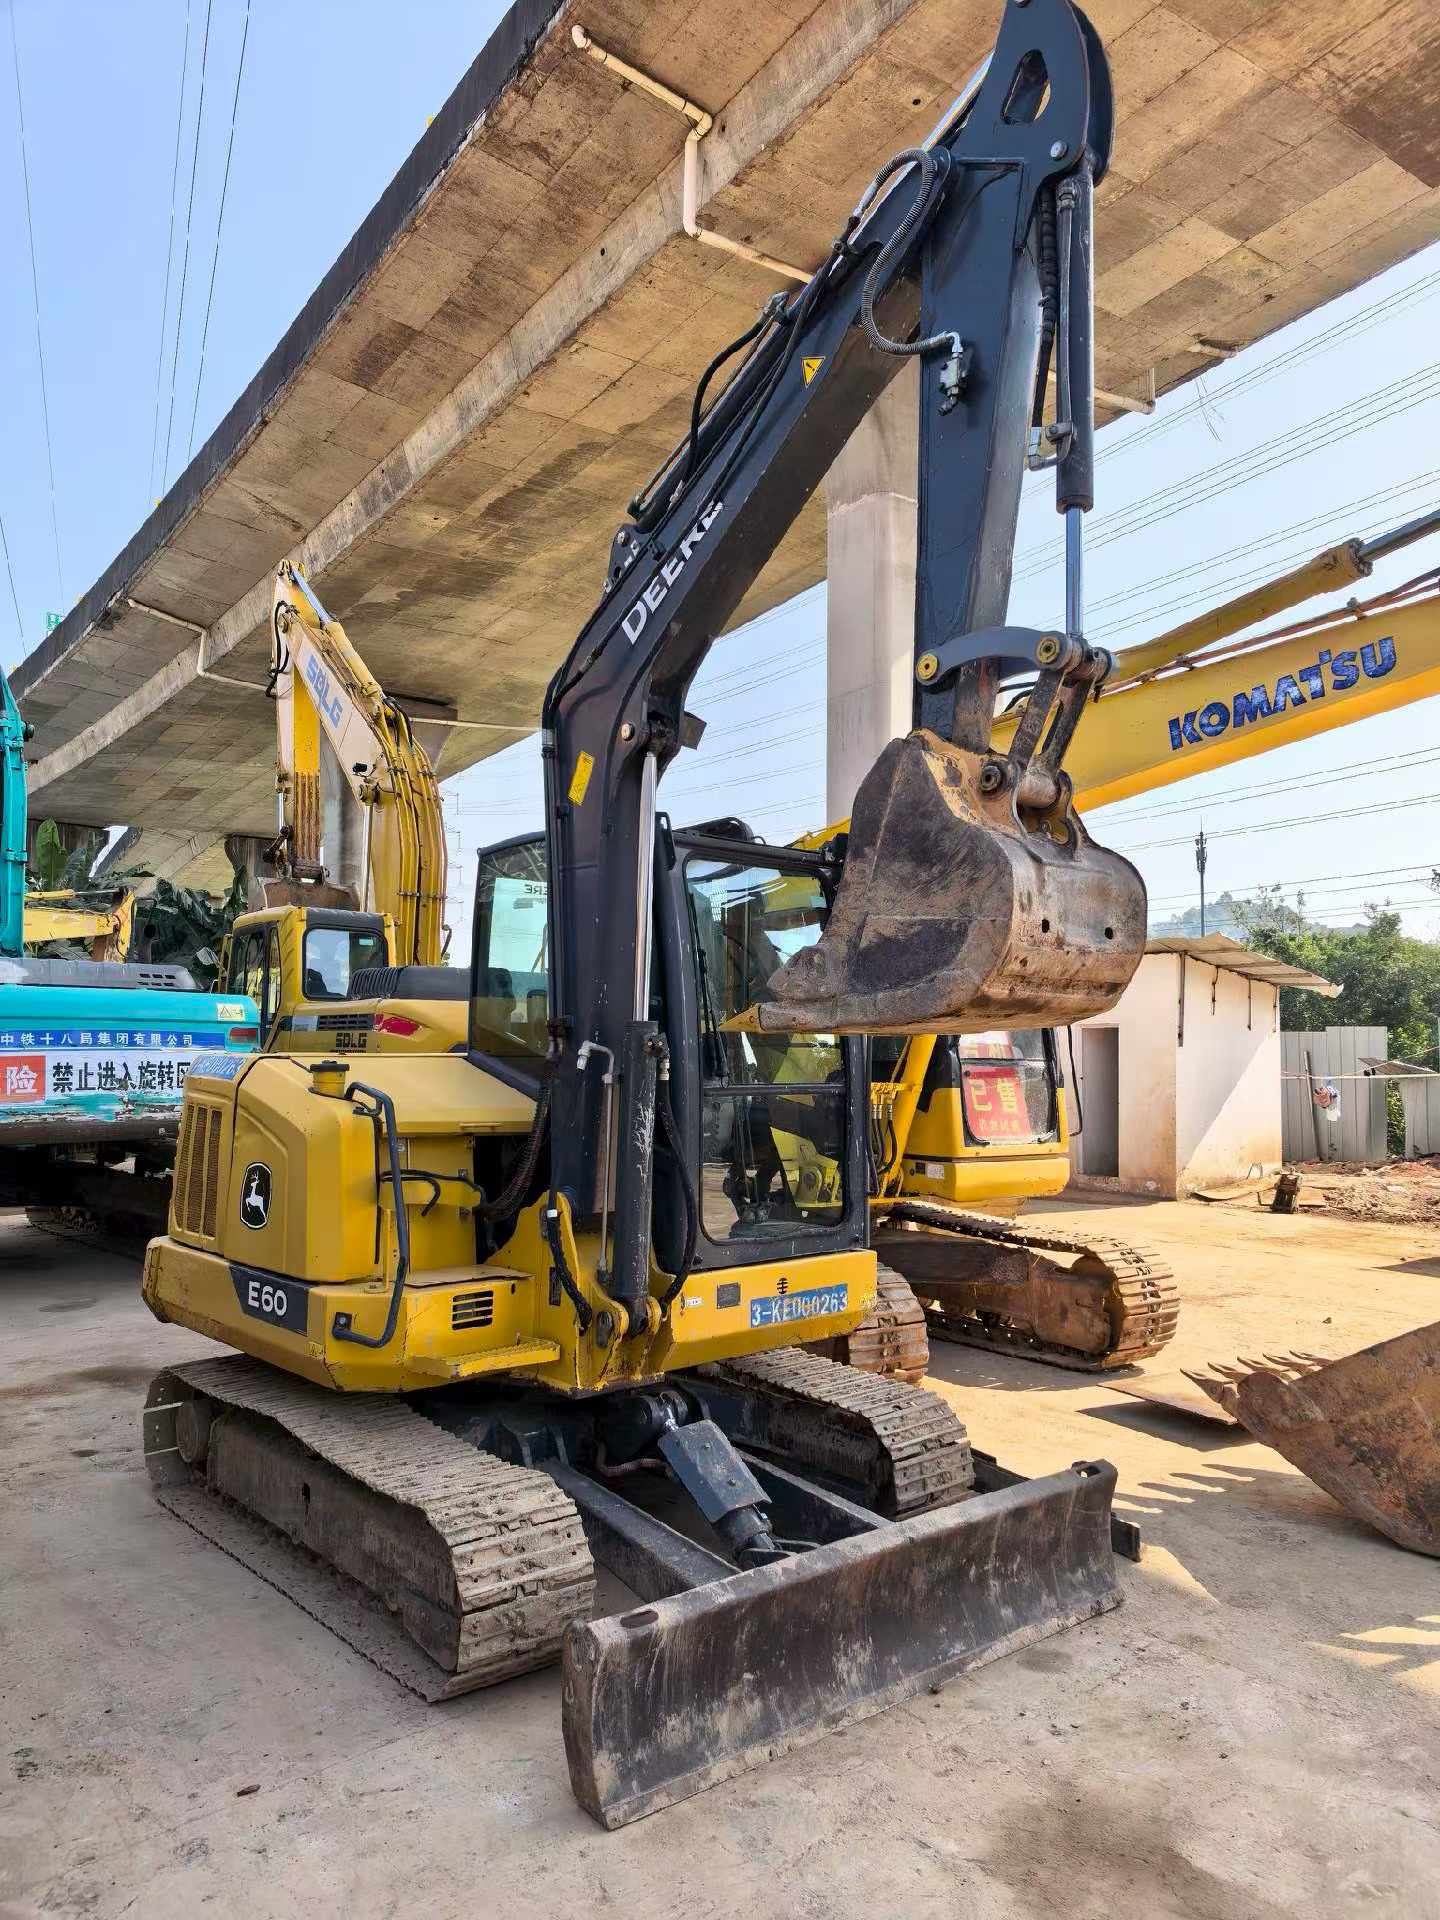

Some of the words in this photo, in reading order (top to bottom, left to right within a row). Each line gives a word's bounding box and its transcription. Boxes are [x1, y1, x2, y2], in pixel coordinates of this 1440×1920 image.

[621, 500, 724, 645] DEERE
[306, 654, 344, 729] SDLG
[1167, 636, 1398, 751] KOMATSU
[0, 1032, 192, 1046] 中铁十八局集团有限公司
[336, 1032, 368, 1048] SDLG
[0, 1065, 38, 1096] 险
[52, 1061, 191, 1094] 禁止进入旋转区
[969, 1078, 1019, 1113] 已售
[248, 1280, 288, 1316] E60
